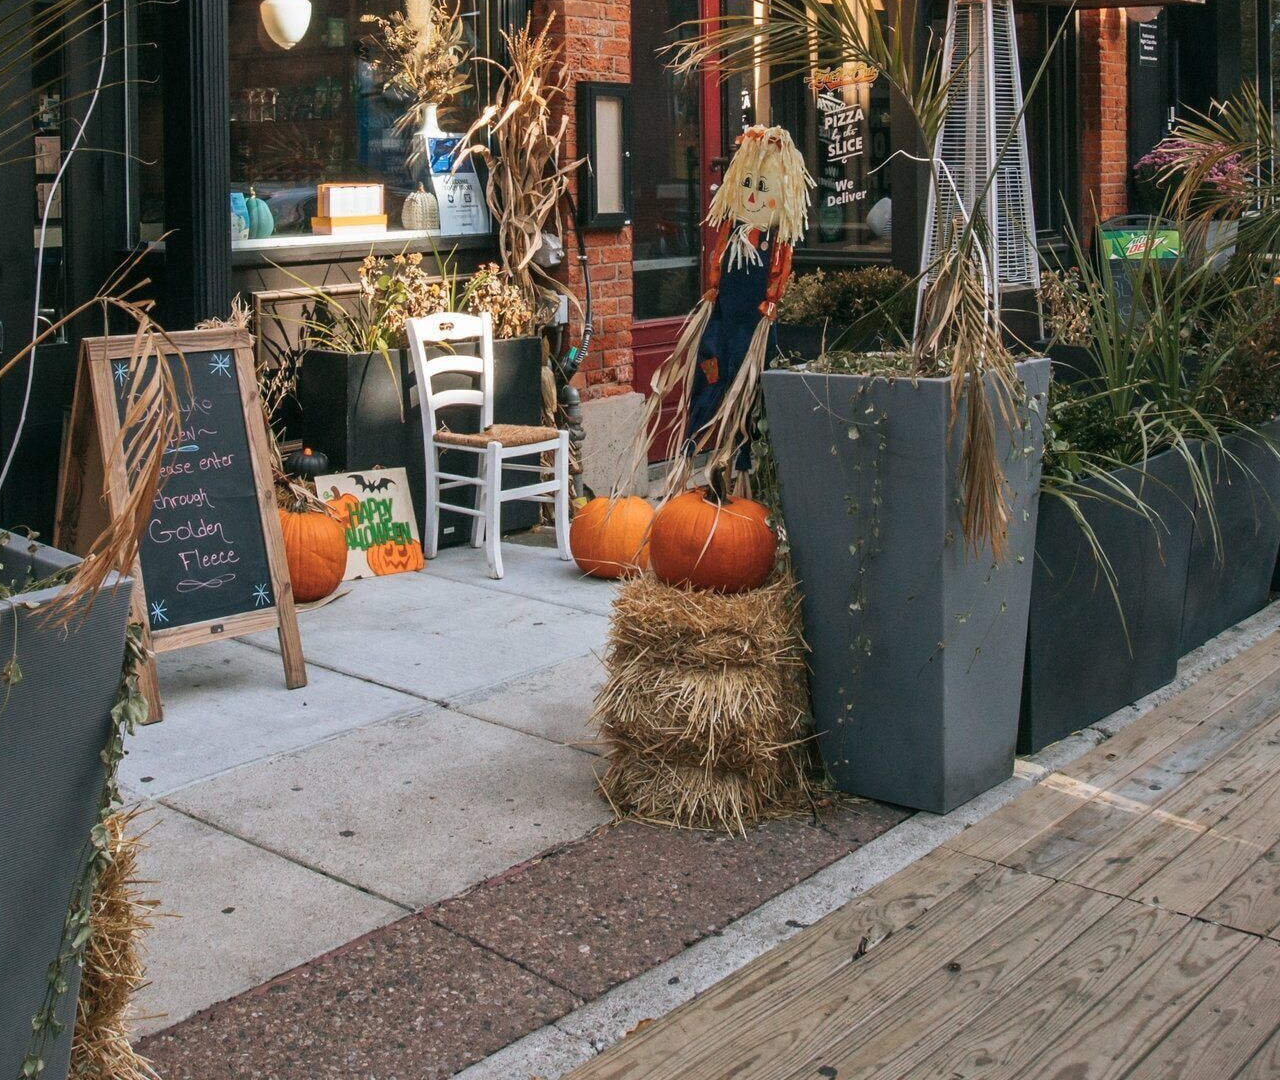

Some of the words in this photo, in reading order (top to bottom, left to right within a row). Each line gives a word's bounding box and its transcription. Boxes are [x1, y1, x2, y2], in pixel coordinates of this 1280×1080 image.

[824, 109, 865, 130] PIZZA
[831, 124, 842, 145] by
[827, 136, 863, 157] SLICE
[835, 178, 854, 193] We
[827, 189, 868, 208] Deliver
[199, 451, 235, 471] enter
[153, 487, 216, 510] through
[345, 497, 393, 531] HAPPY
[149, 518, 234, 544] Golden
[345, 521, 413, 551] ALLOWEEN
[178, 548, 241, 572] Fleece
